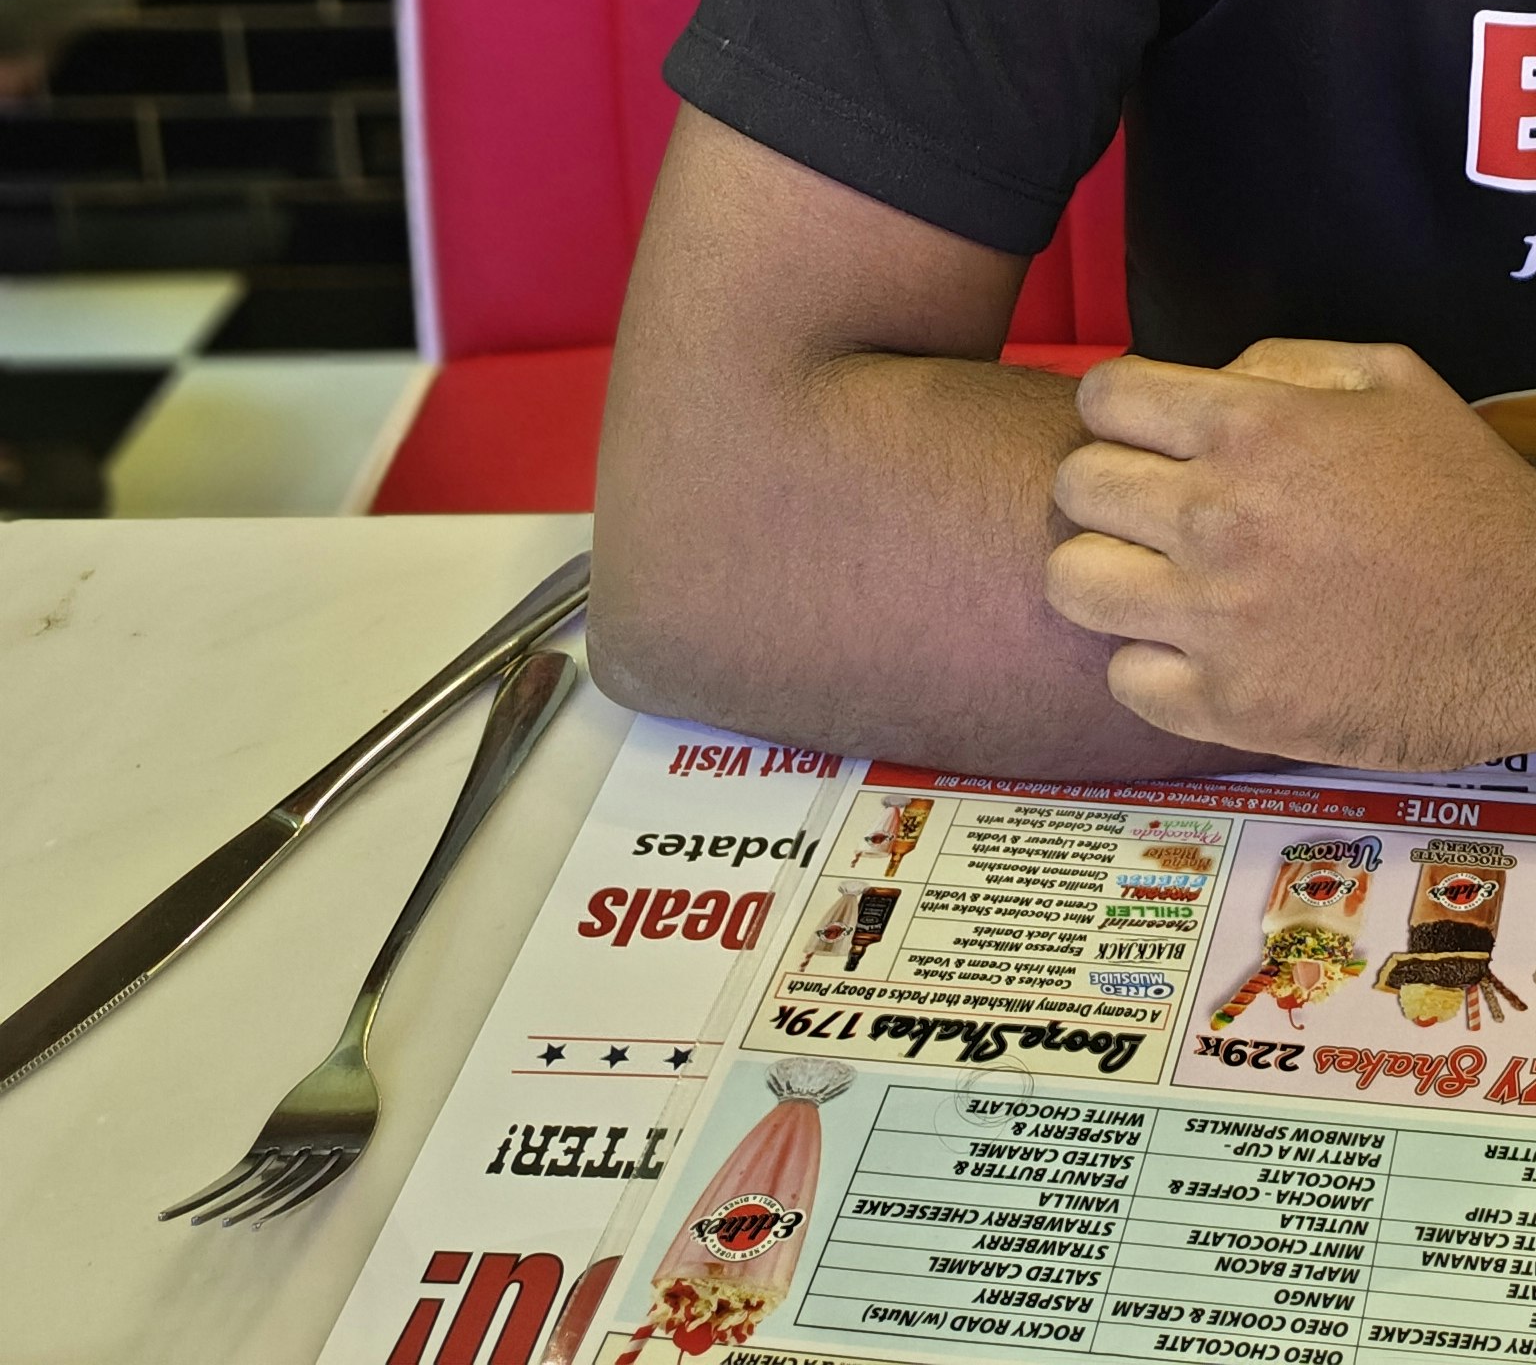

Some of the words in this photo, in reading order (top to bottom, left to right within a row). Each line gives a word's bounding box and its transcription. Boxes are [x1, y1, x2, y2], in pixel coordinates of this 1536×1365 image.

[668, 745, 754, 778] Visit
[759, 747, 844, 779] Next
[1396, 799, 1480, 827] NOTE:
[1281, 836, 1382, 872] Unicorn
[1411, 847, 1516, 869] CHOCOLATE
[577, 887, 776, 951] Deals
[1105, 905, 1194, 918] CHILLER
[972, 925, 1023, 939] Daniels
[1026, 930, 1057, 943] Jack
[1059, 932, 1088, 943] with
[952, 937, 1023, 952] Milkshake
[1025, 941, 1084, 957] Espresso
[908, 954, 952, 967] Vodka
[954, 958, 966, 969] &
[967, 959, 1012, 972] Cream
[1014, 963, 1044, 974] Irish
[1046, 965, 1077, 976] with
[913, 968, 956, 982] Shake
[958, 971, 1003, 985] Cream
[1004, 975, 1016, 985] &
[1018, 975, 1072, 990] Cookies
[1088, 971, 1164, 985] MUDSLIDE
[787, 980, 832, 997] Punch
[831, 980, 873, 1000] Boozy
[878, 988, 888, 997] a
[890, 988, 930, 1005] Packs
[1100, 983, 1174, 1000] OREO
[932, 991, 961, 1008] that
[962, 994, 1035, 1013] Milkshake
[1036, 997, 1092, 1018] Dreamy
[1093, 1002, 1148, 1021] Creamy
[1149, 1010, 1162, 1023] A
[867, 1014, 1017, 1063] Shakes
[1019, 1021, 1147, 1074] Booze
[1313, 1045, 1487, 1096] Shakes
[966, 1098, 1081, 1123] CHOCOLATE
[1081, 1107, 1146, 1127] WHITE
[1010, 1121, 1027, 1137] &
[1027, 1123, 1142, 1146] RASPBERRY
[1184, 1117, 1289, 1140] SPRINKLES
[1290, 1127, 1386, 1149] RAINBOW
[485, 1124, 683, 1180] TTER!
[968, 1141, 1059, 1164] CARAMEL
[1060, 1150, 1135, 1170] SALTED
[1233, 1141, 1274, 1158] CUP
[1278, 1145, 1292, 1160] A
[1296, 1147, 1316, 1163] IN
[1317, 1149, 1382, 1168] PARTY
[953, 1160, 970, 1175] &
[971, 1160, 1047, 1182] BUTTER
[1048, 1168, 1129, 1189] PEANUT
[1168, 1179, 1184, 1195] &
[1257, 1168, 1376, 1192] CHOCOLATE
[1185, 1181, 1260, 1202] COFFEE
[1276, 1189, 1374, 1212] JAMOCHA
[852, 1198, 980, 1225] CHEESECAKE
[1038, 1191, 1120, 1214] VANILLA
[980, 1210, 1116, 1237] STRAWBERRY
[1280, 1214, 1370, 1236] NUTELLA
[1465, 1207, 1513, 1225] CHIP
[690, 1212, 803, 1243] Eddie's
[1414, 1226, 1510, 1249] CARAMEL
[971, 1233, 1110, 1260] STRAWBERRY
[1187, 1229, 1308, 1255] CHOCOLATE
[1310, 1242, 1365, 1260] MINT
[928, 1255, 1023, 1280] CARAMEL
[1214, 1256, 1287, 1277] BACON
[1422, 1251, 1507, 1274] BANANA
[1025, 1265, 1102, 1287] SALTED
[1289, 1263, 1361, 1284] MAPLE
[971, 1287, 1094, 1313] RASPBERRY
[1274, 1289, 1356, 1311] MANGO
[862, 1304, 948, 1330] (w/Nuts)
[1111, 1300, 1185, 1322] CREAM
[1188, 1307, 1206, 1323] &
[1206, 1309, 1287, 1332] COOKIE
[949, 1315, 1011, 1336] ROAD
[1010, 1320, 1086, 1342] ROCKY
[1290, 1317, 1349, 1338] OREO
[1154, 1333, 1281, 1361] CHOCOLATE
[1368, 1325, 1501, 1352] CHEESECAKE
[1284, 1346, 1344, 1365] OREO
